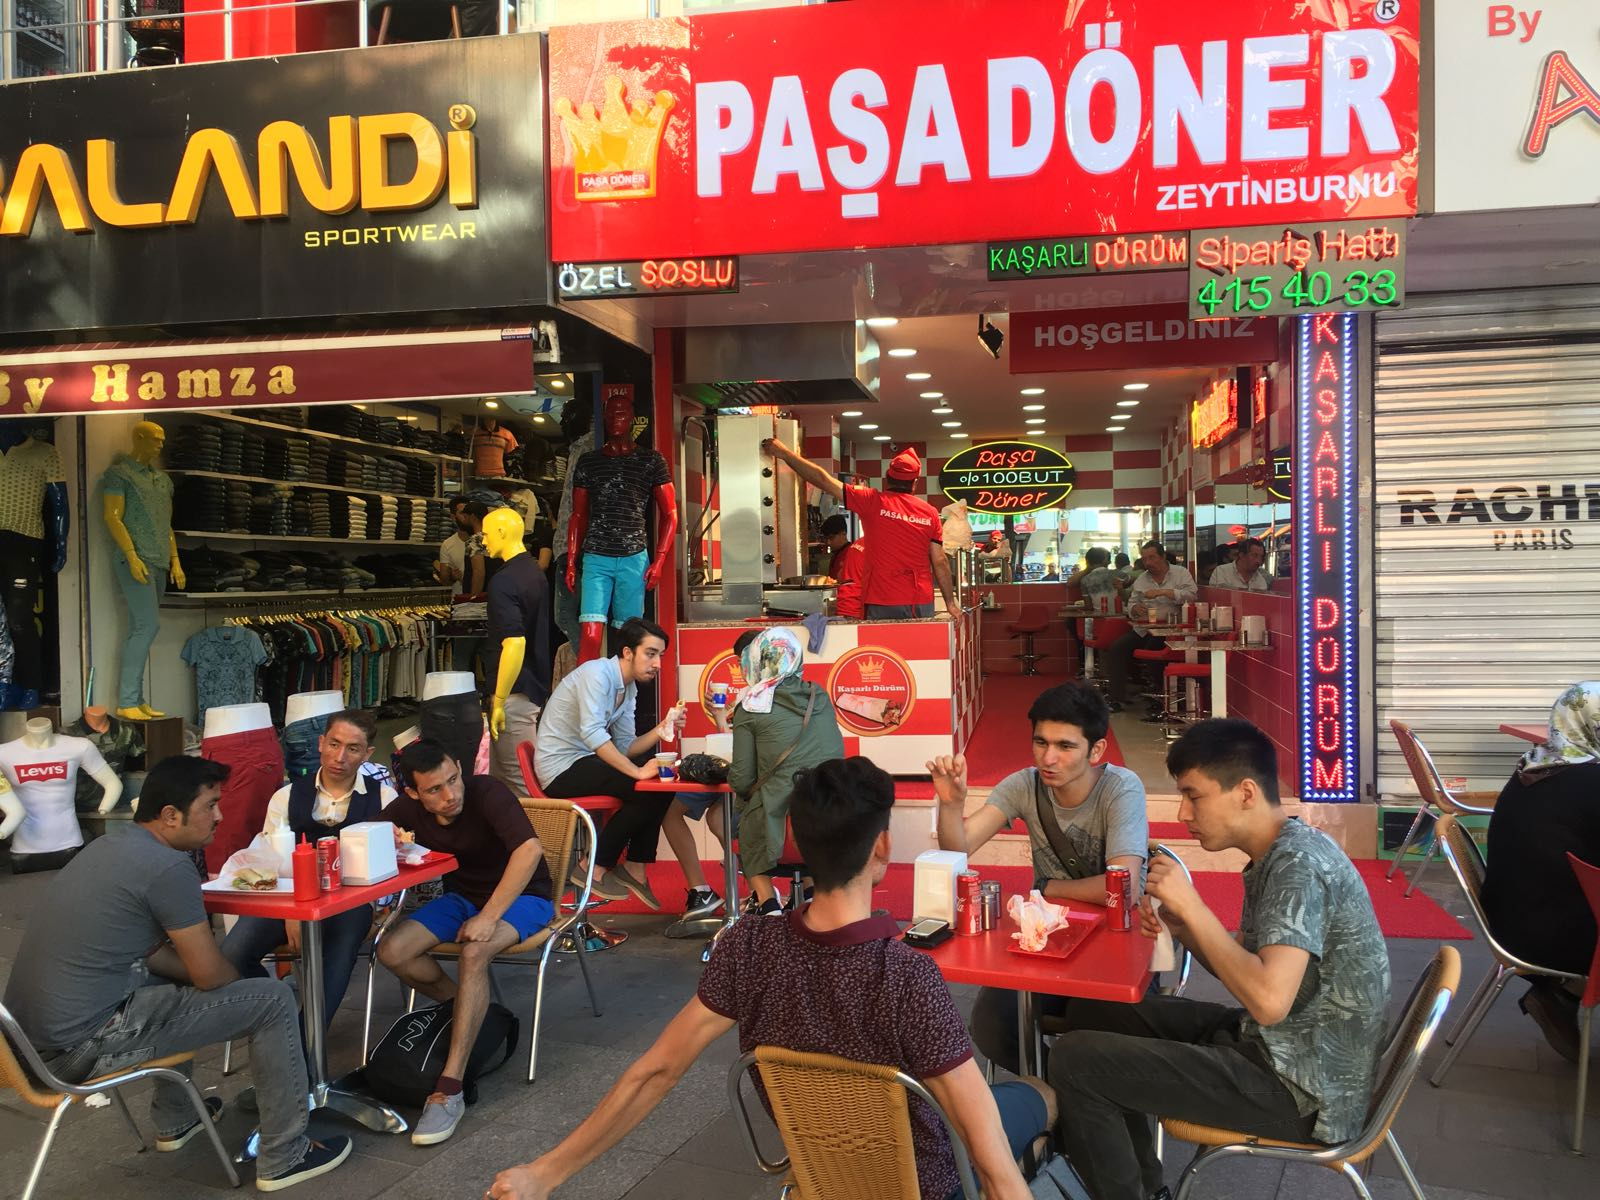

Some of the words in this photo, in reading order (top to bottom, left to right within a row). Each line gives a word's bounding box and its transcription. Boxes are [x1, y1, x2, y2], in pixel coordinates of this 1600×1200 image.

[1488, 4, 1542, 43] By
[695, 64, 972, 218] PAŞA
[987, 21, 1401, 179] DÖNER
[1518, 49, 1600, 159] A
[304, 222, 477, 248] SPORTWEAR
[990, 242, 1088, 275] KAŞARLI
[1094, 234, 1187, 265] DÜRÜM
[1195, 229, 1312, 274] Sipariş
[558, 262, 632, 291] ÖZEL
[640, 260, 732, 285] SOSLU
[1198, 276, 1273, 315] 415
[1282, 271, 1332, 307] 40
[1344, 269, 1397, 305] 33
[91, 363, 297, 403] Hamza
[1493, 528, 1575, 551] PARIS
[873, 684, 905, 692] Dürüm
